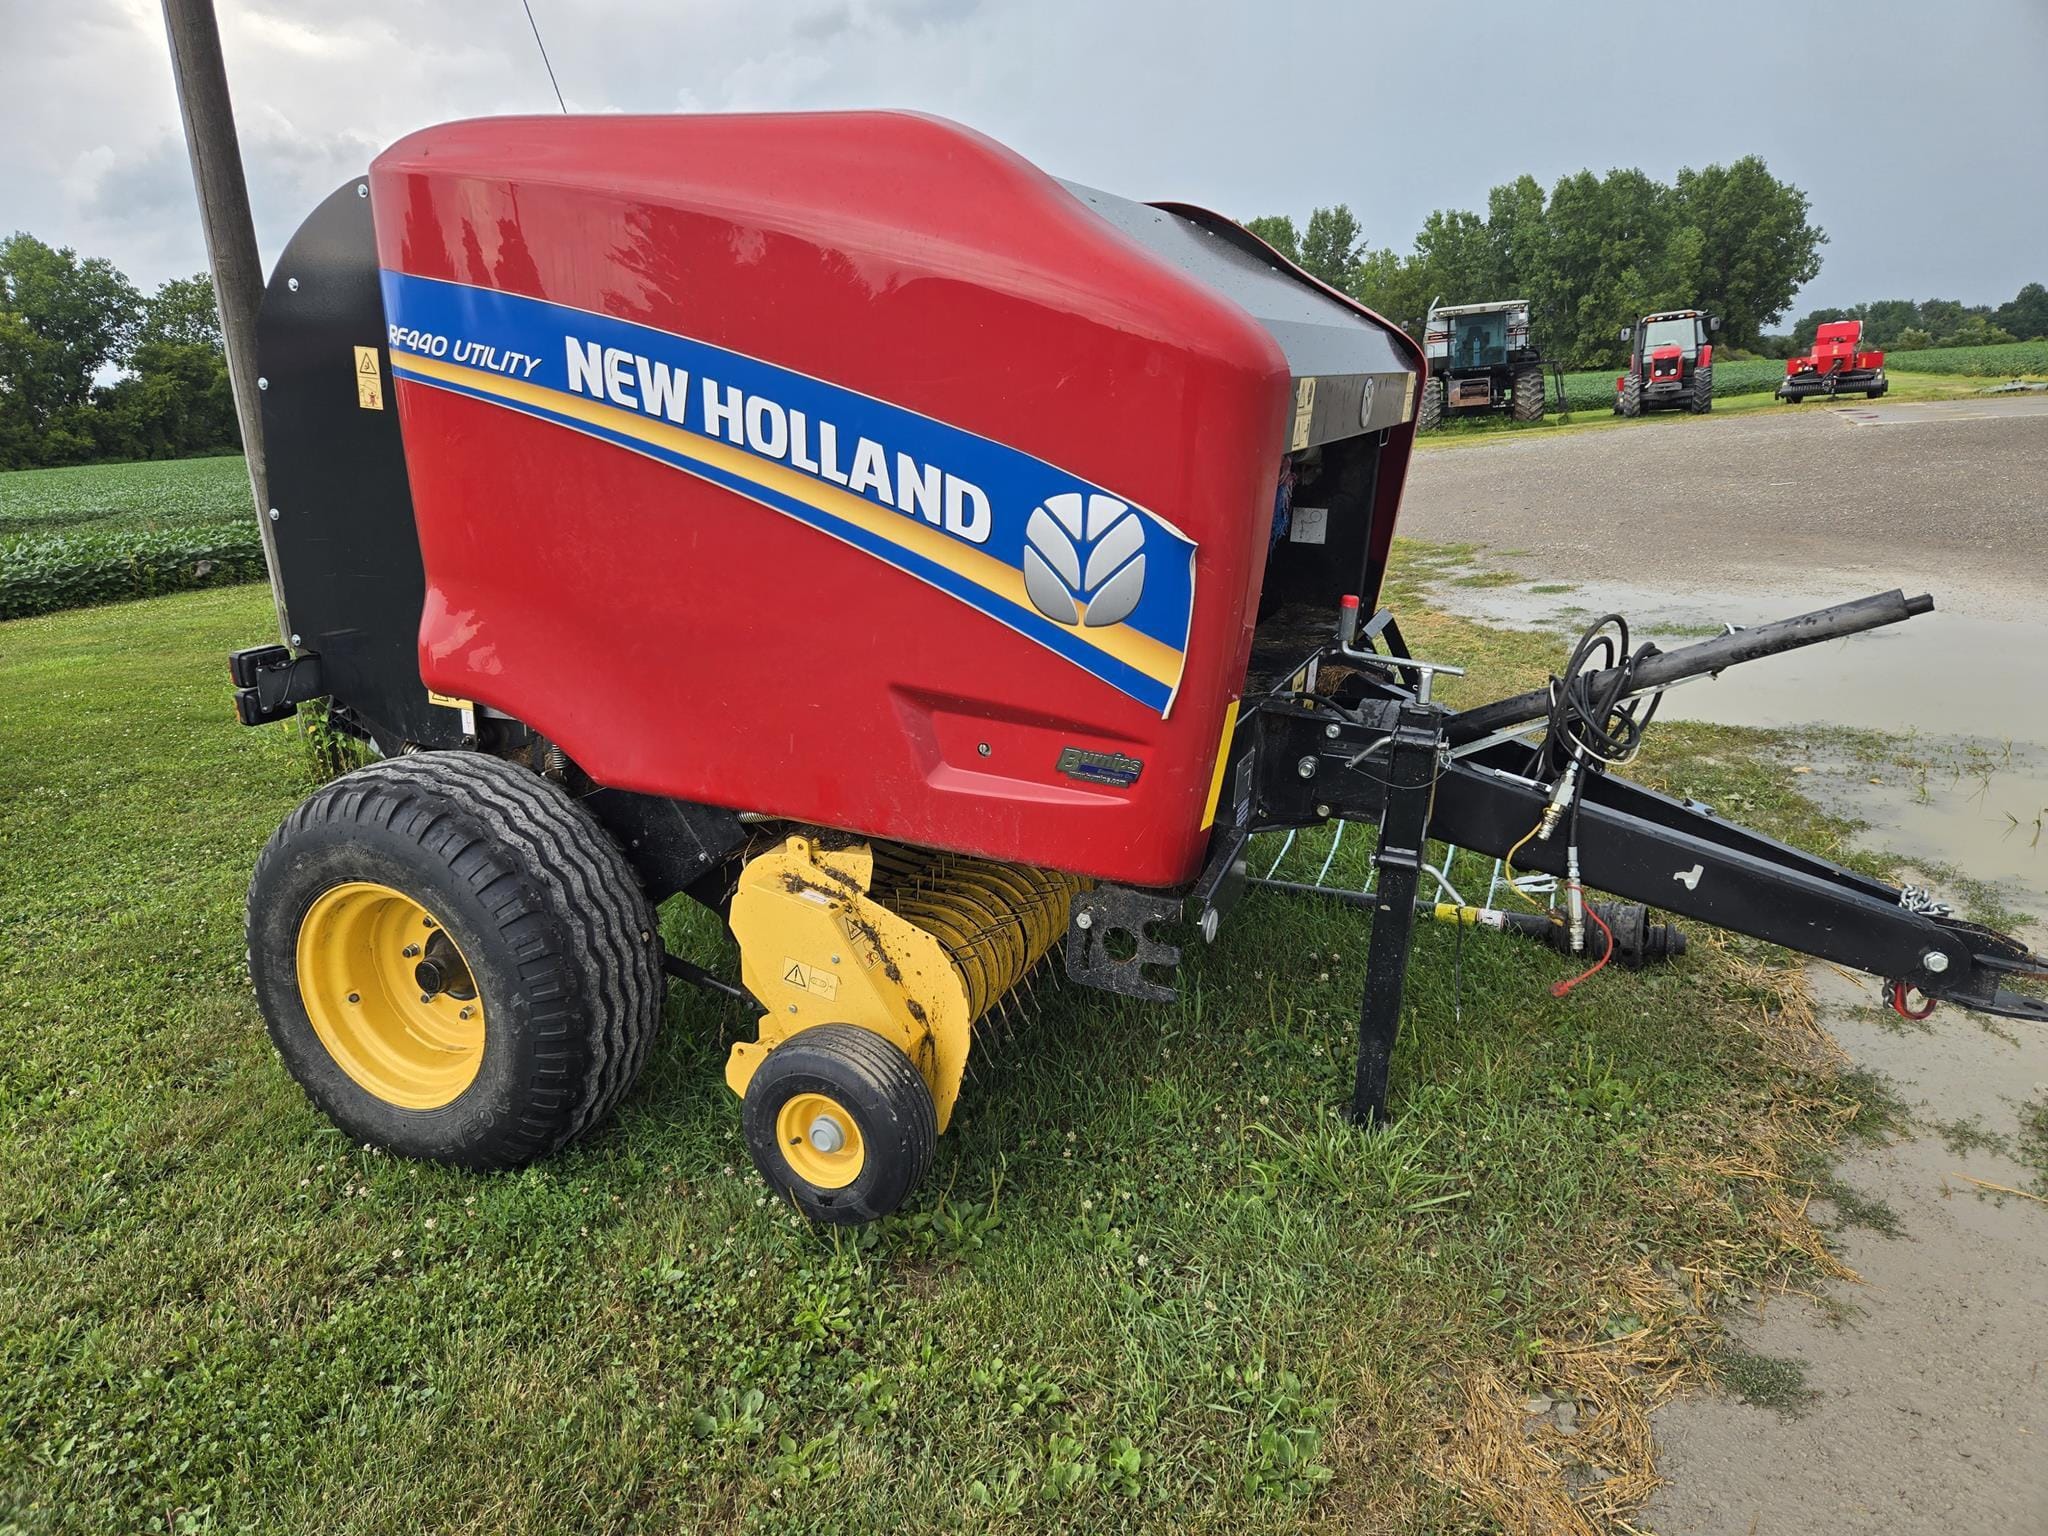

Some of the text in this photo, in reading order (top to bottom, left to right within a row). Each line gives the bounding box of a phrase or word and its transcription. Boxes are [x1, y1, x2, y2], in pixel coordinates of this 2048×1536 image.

[389, 324, 542, 377] RF440 UTILITY
[565, 336, 992, 543] NEW HOLLAND
